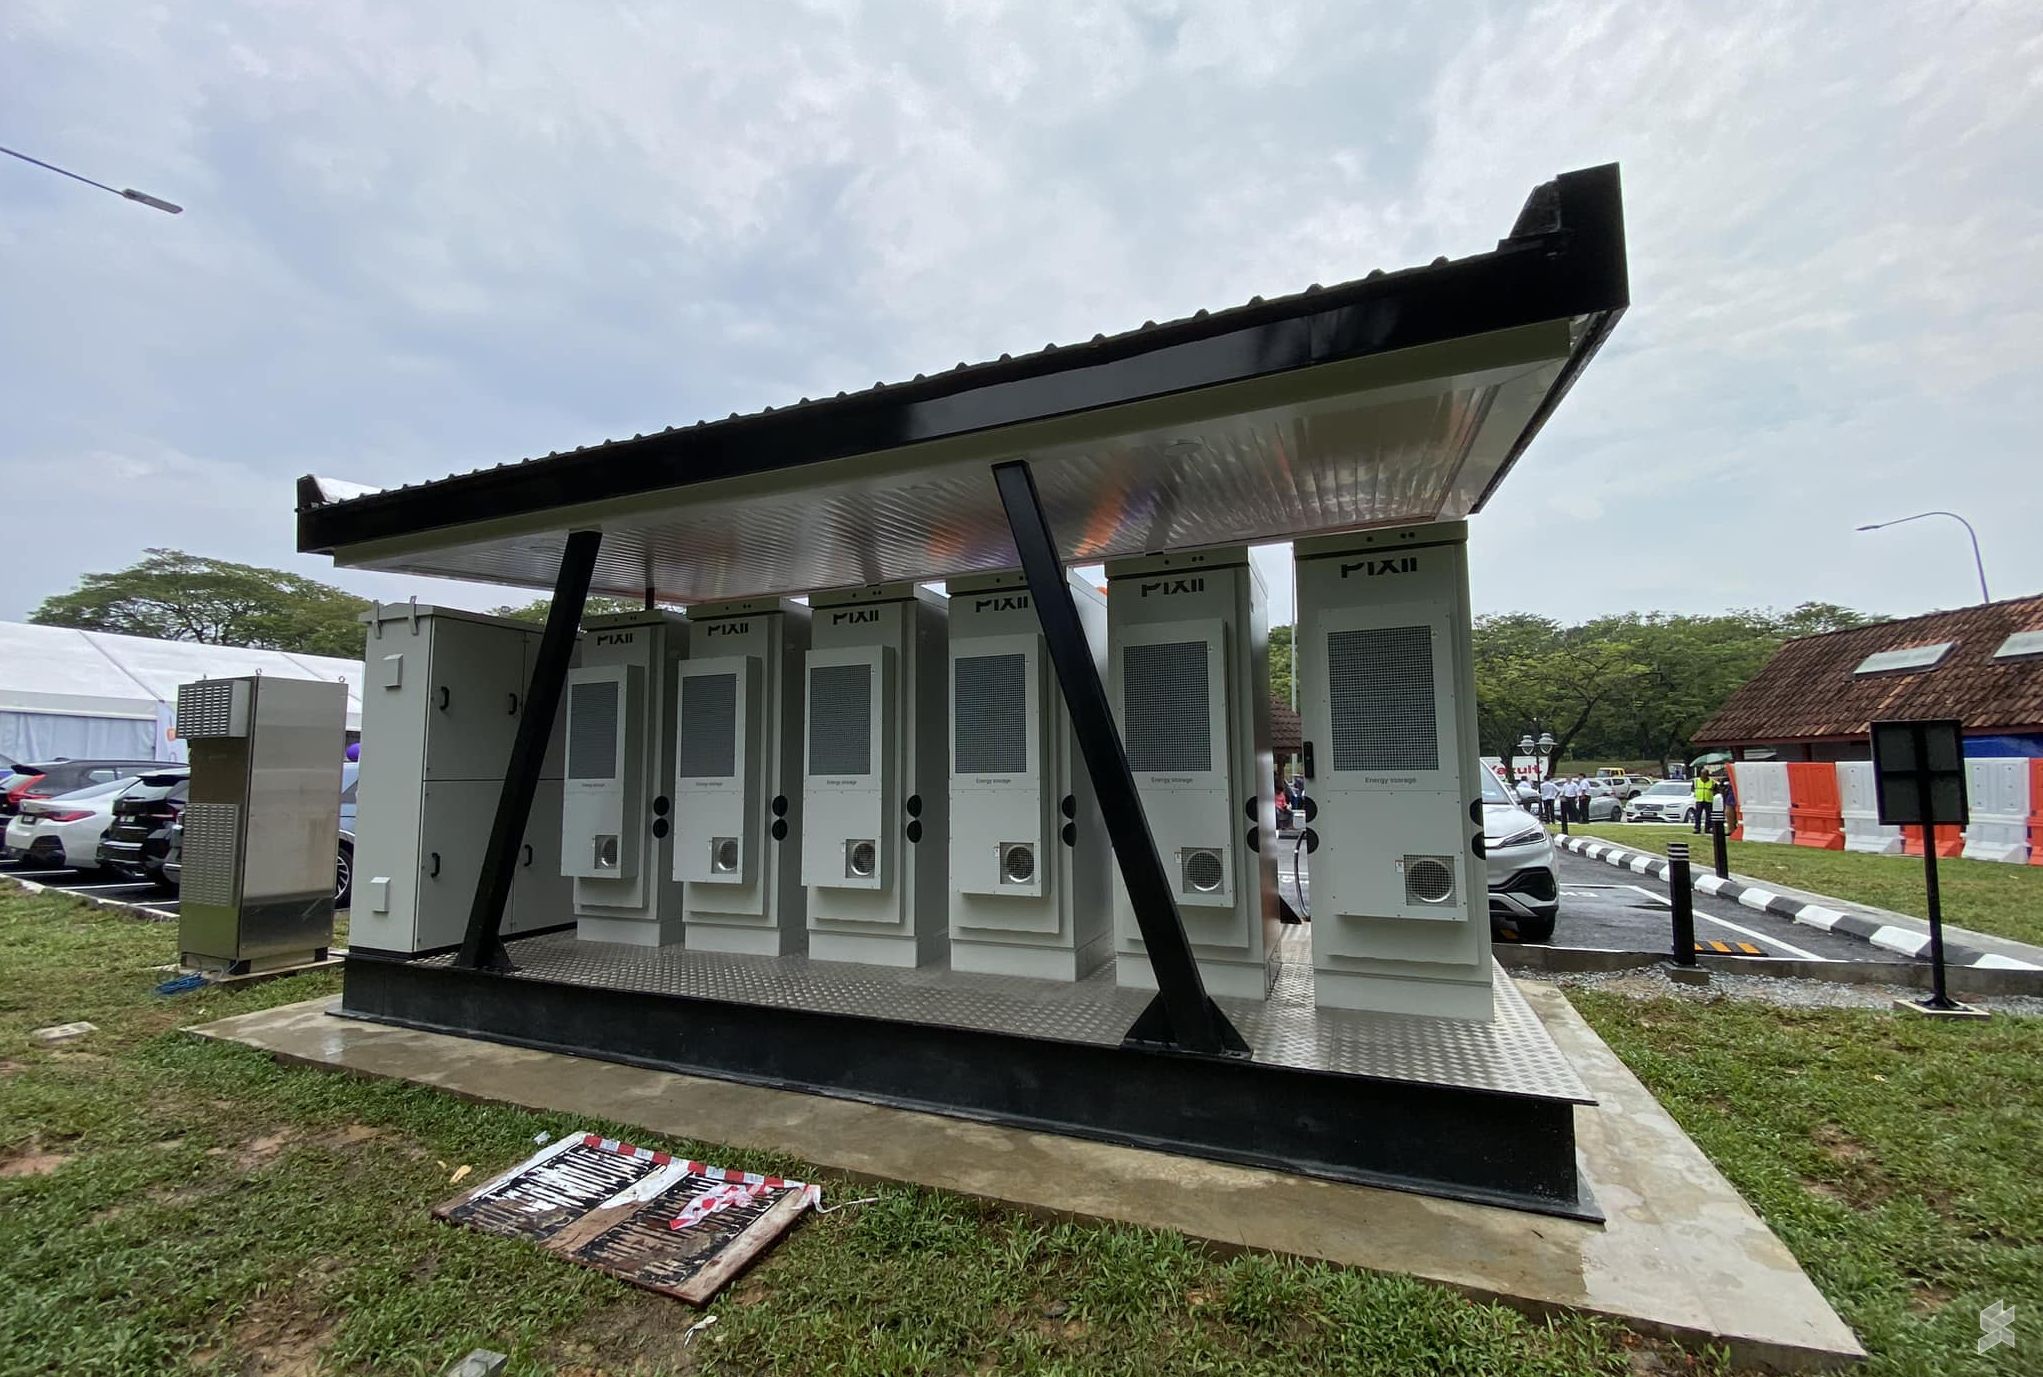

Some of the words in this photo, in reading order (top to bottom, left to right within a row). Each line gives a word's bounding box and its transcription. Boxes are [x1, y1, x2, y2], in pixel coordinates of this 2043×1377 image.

[1341, 557, 1417, 578] PIXII
[1141, 578, 1204, 597] PIXII
[1151, 776, 1170, 784] Energy
[1364, 777, 1389, 785] Energy
